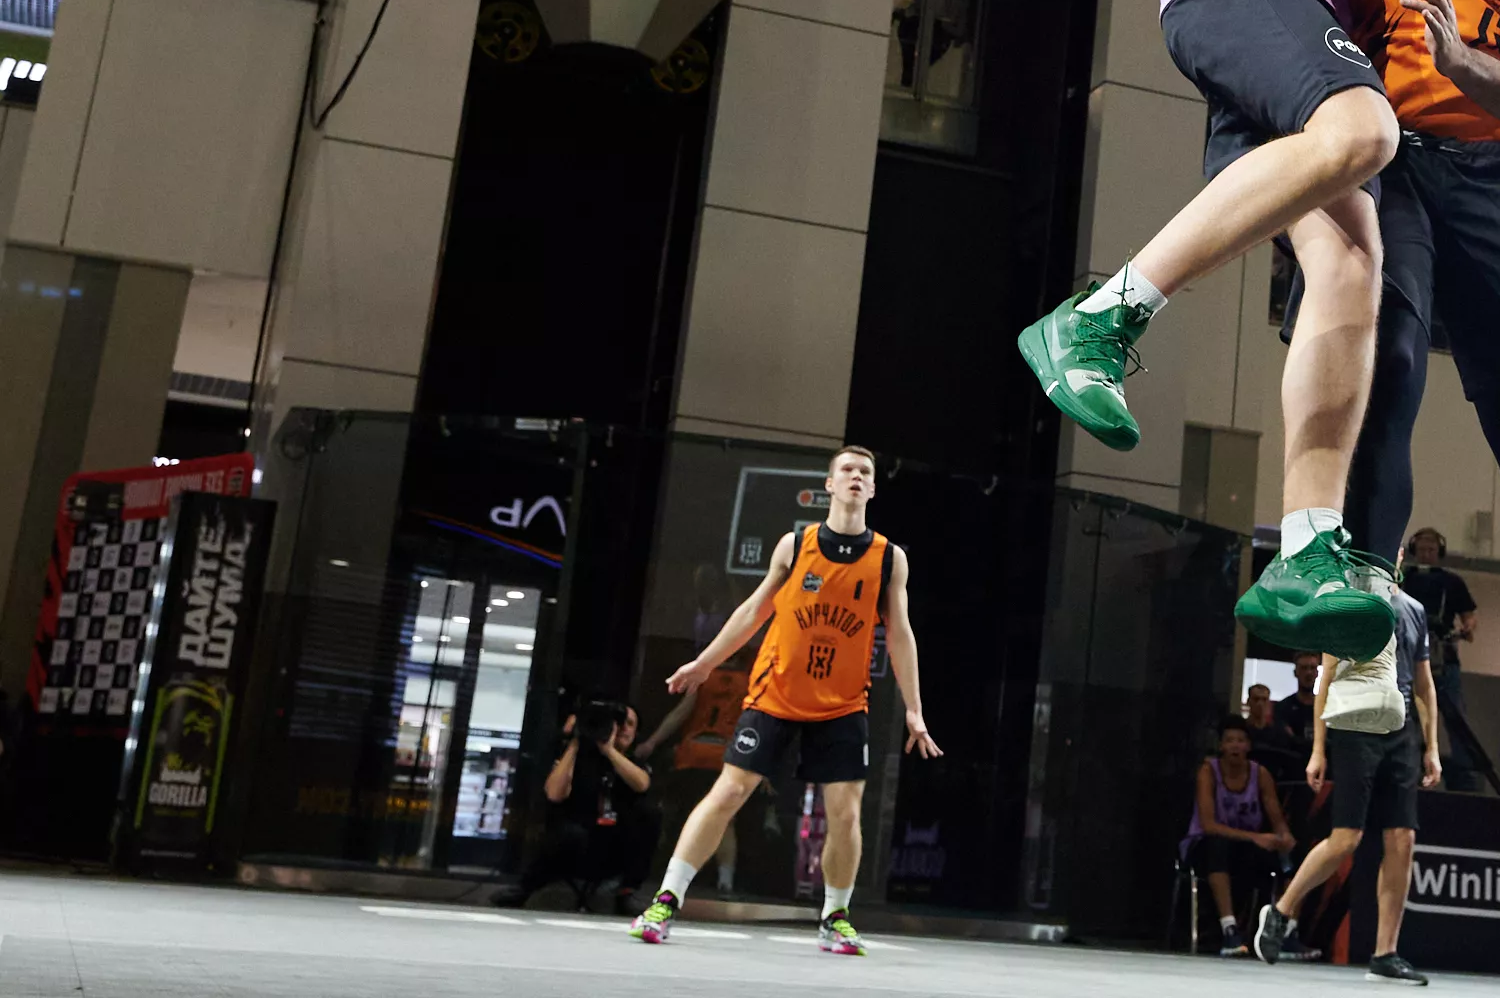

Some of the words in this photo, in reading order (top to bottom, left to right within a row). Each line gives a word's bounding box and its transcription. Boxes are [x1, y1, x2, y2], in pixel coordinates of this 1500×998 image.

[177, 517, 226, 667] ДАЙТЕ
[794, 602, 865, 639] КУРЧАТОВ
[148, 781, 208, 807] GORILLA
